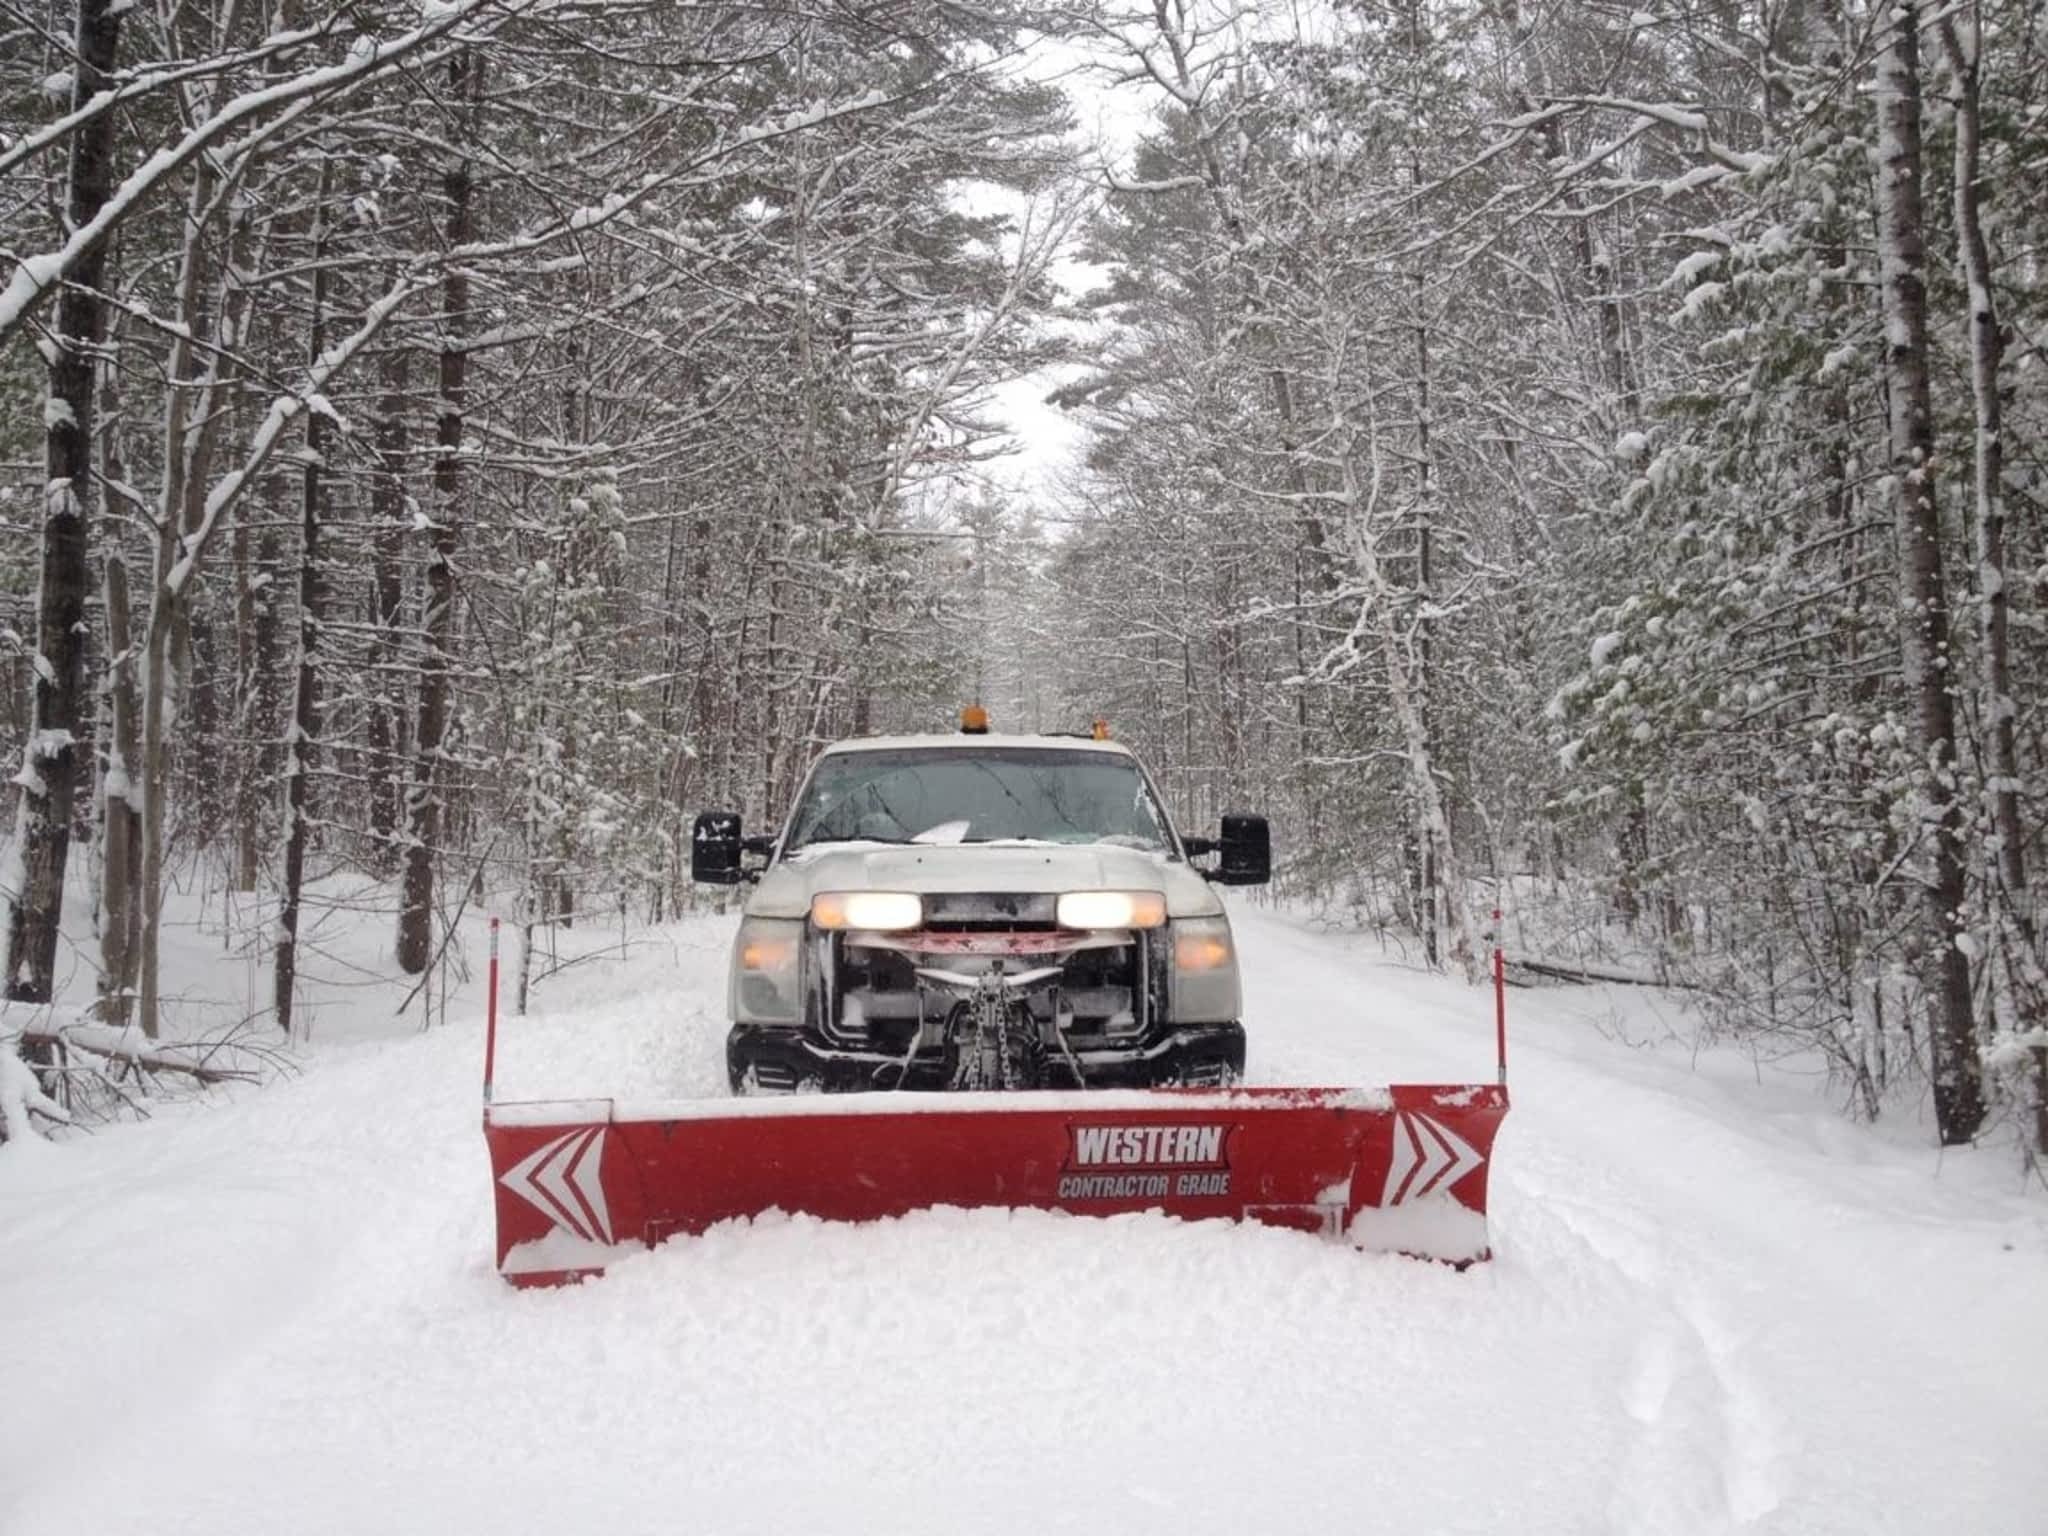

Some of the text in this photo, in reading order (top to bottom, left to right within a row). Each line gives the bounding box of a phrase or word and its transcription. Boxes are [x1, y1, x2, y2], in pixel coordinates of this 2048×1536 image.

[1077, 1126, 1223, 1165] WESTERN
[1058, 1173, 1231, 1198] CONTRACTOR GRADE
